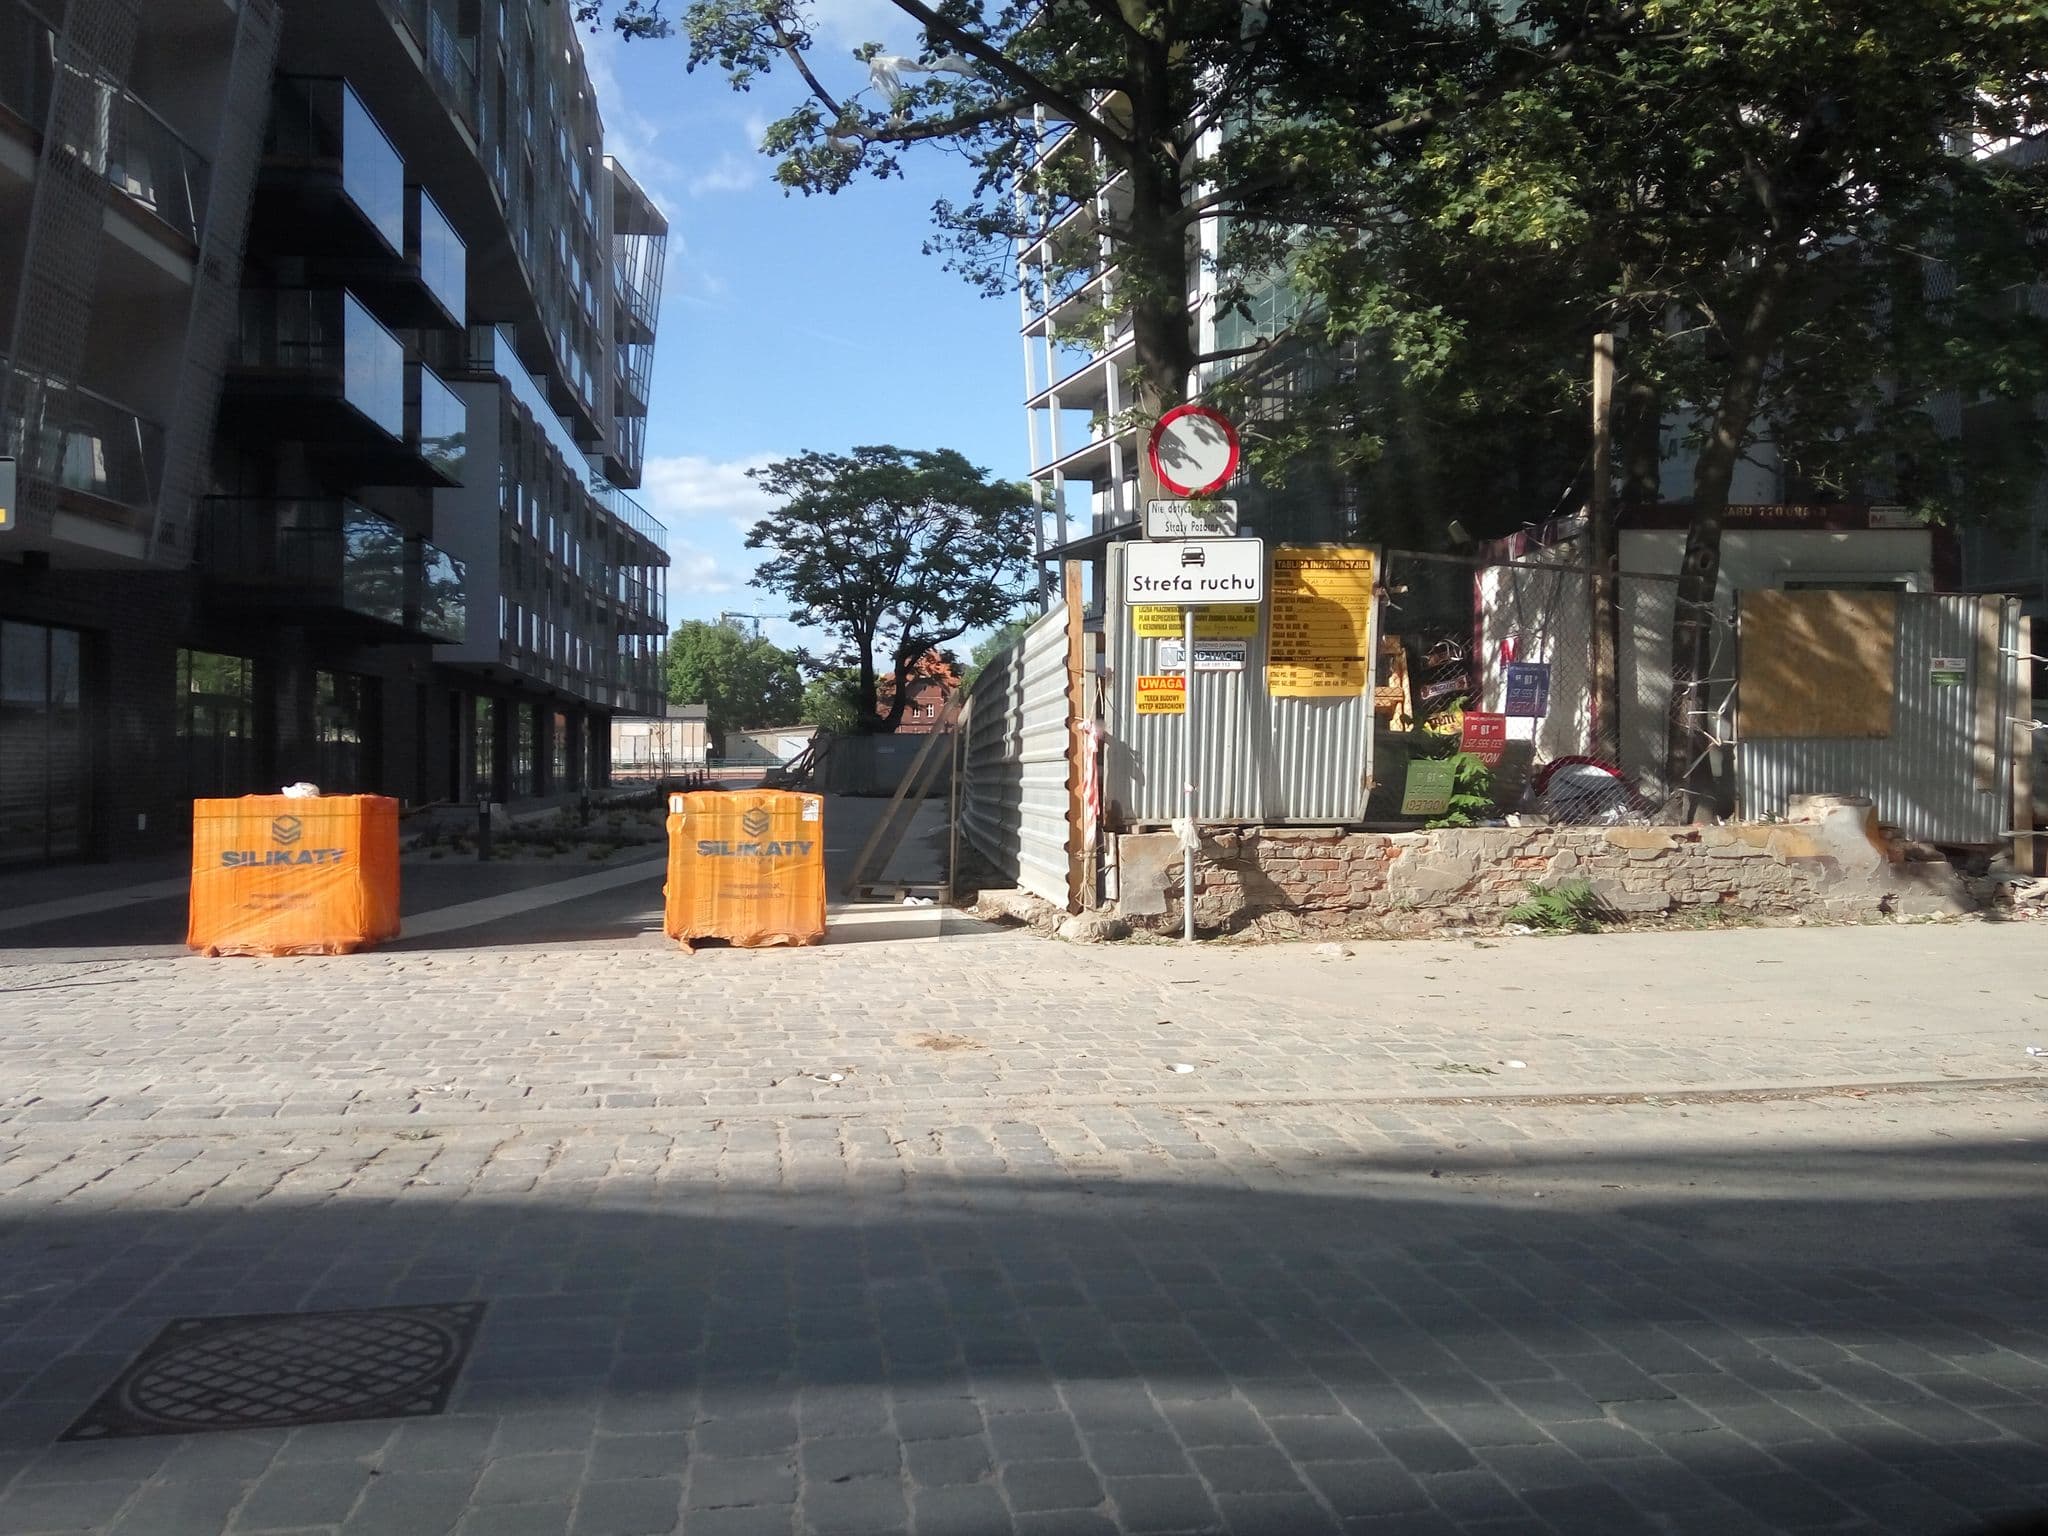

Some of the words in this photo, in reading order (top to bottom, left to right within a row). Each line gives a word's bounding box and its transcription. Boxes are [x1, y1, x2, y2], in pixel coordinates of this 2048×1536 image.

[1133, 575, 1192, 591] Strefa
[1200, 574, 1255, 590] ruchu
[1177, 651, 1245, 660] NRD-WACHT
[1141, 678, 1183, 688] UWAGA
[221, 848, 344, 867] SILIKATY
[695, 840, 815, 858] SILIKATY
